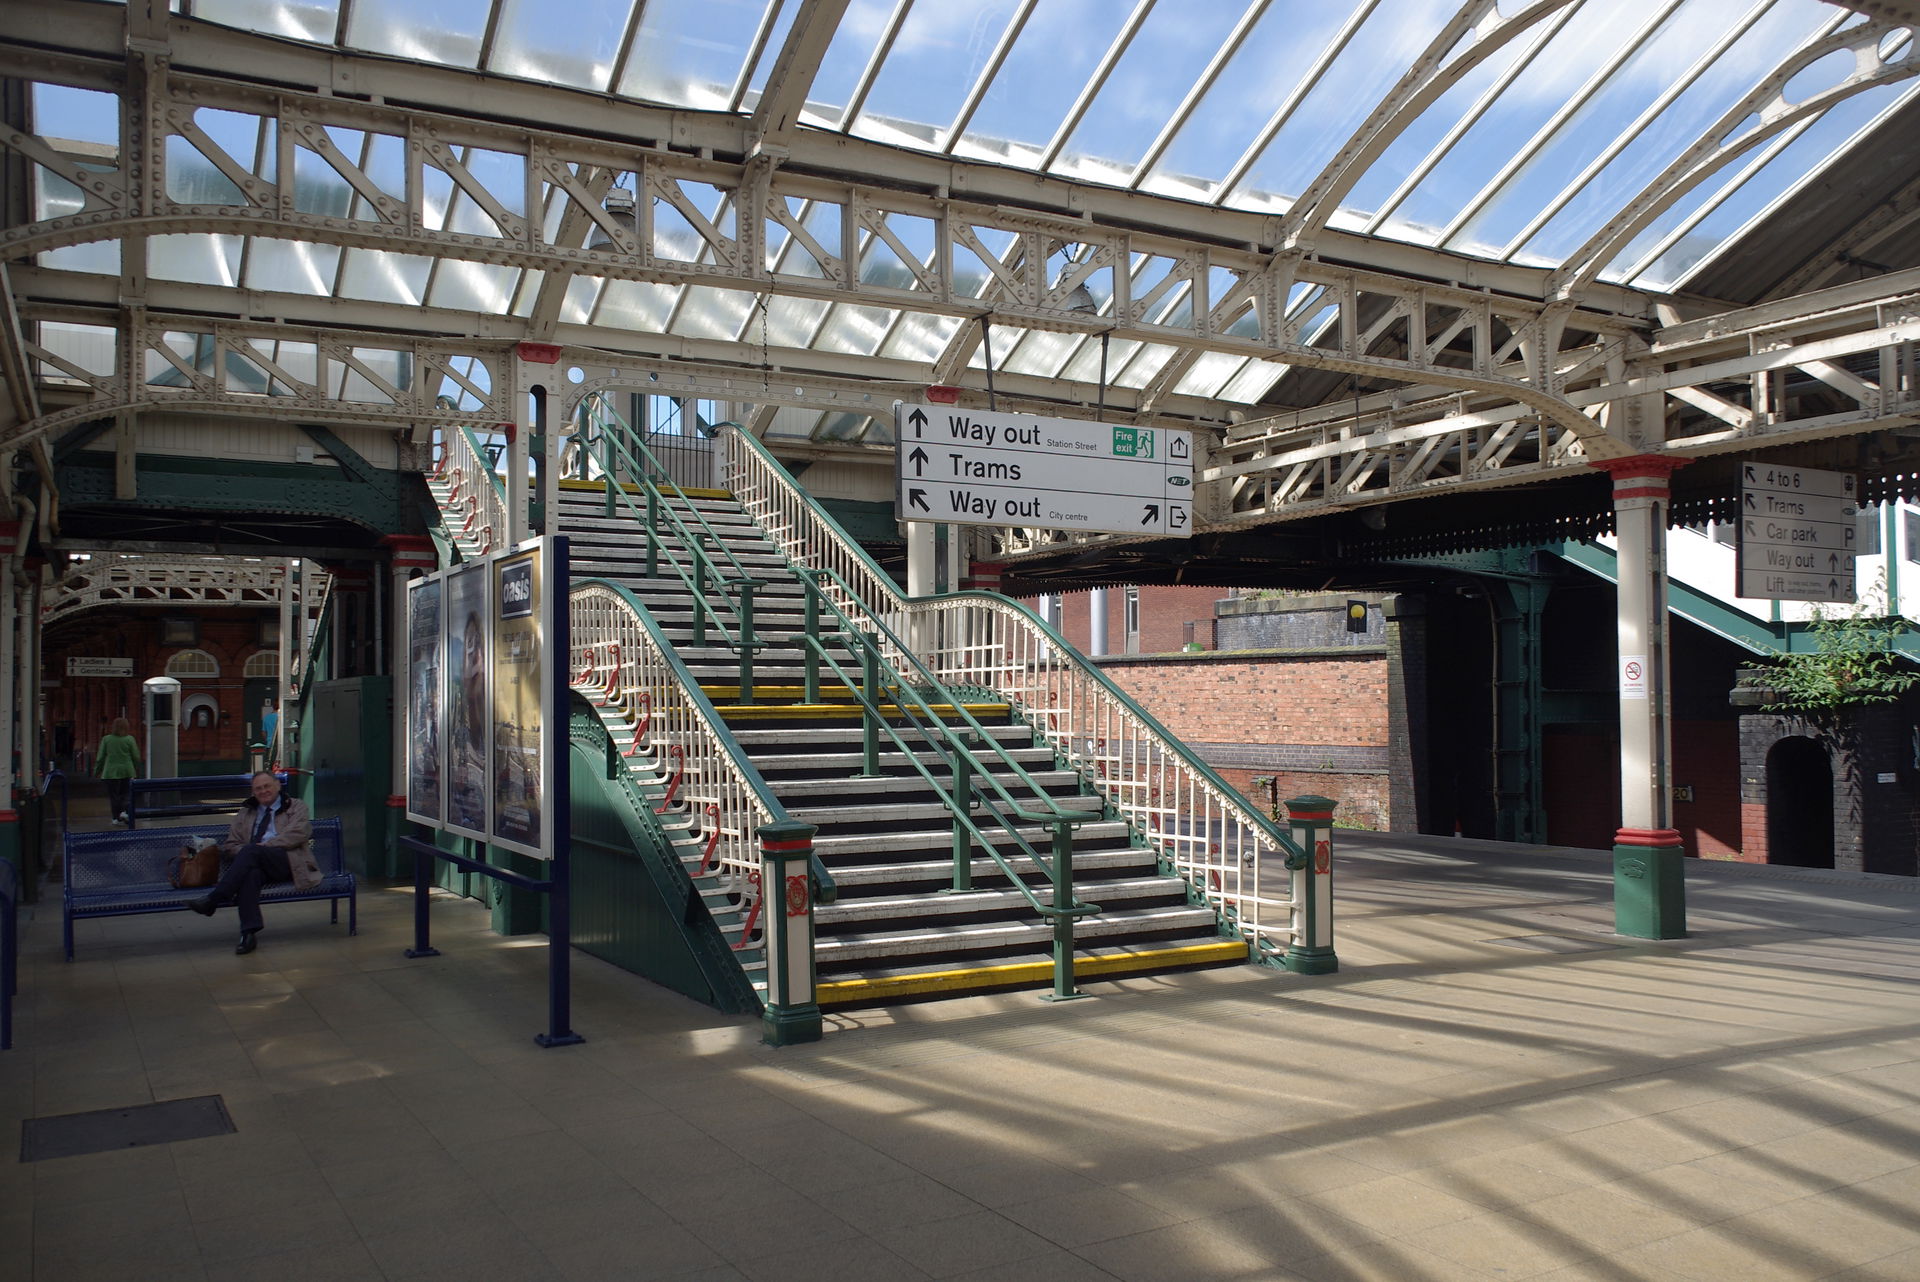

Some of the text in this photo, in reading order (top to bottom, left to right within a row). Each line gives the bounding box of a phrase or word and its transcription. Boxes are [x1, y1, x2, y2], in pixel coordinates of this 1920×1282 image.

[949, 416, 1097, 451] Way out Station Street
[1115, 431, 1133, 441] Fire
[1116, 443, 1132, 453] exit
[949, 454, 1021, 480] Trams
[1170, 477, 1187, 485] NET
[1766, 470, 1800, 488] 4 to 6
[950, 490, 1088, 521] Way out City centre
[1766, 496, 1804, 515] Trams
[1766, 522, 1817, 543] Car park
[1844, 527, 1854, 547] P
[1767, 549, 1814, 569] Way out
[503, 572, 530, 603] oasis
[1766, 576, 1785, 592] Lift
